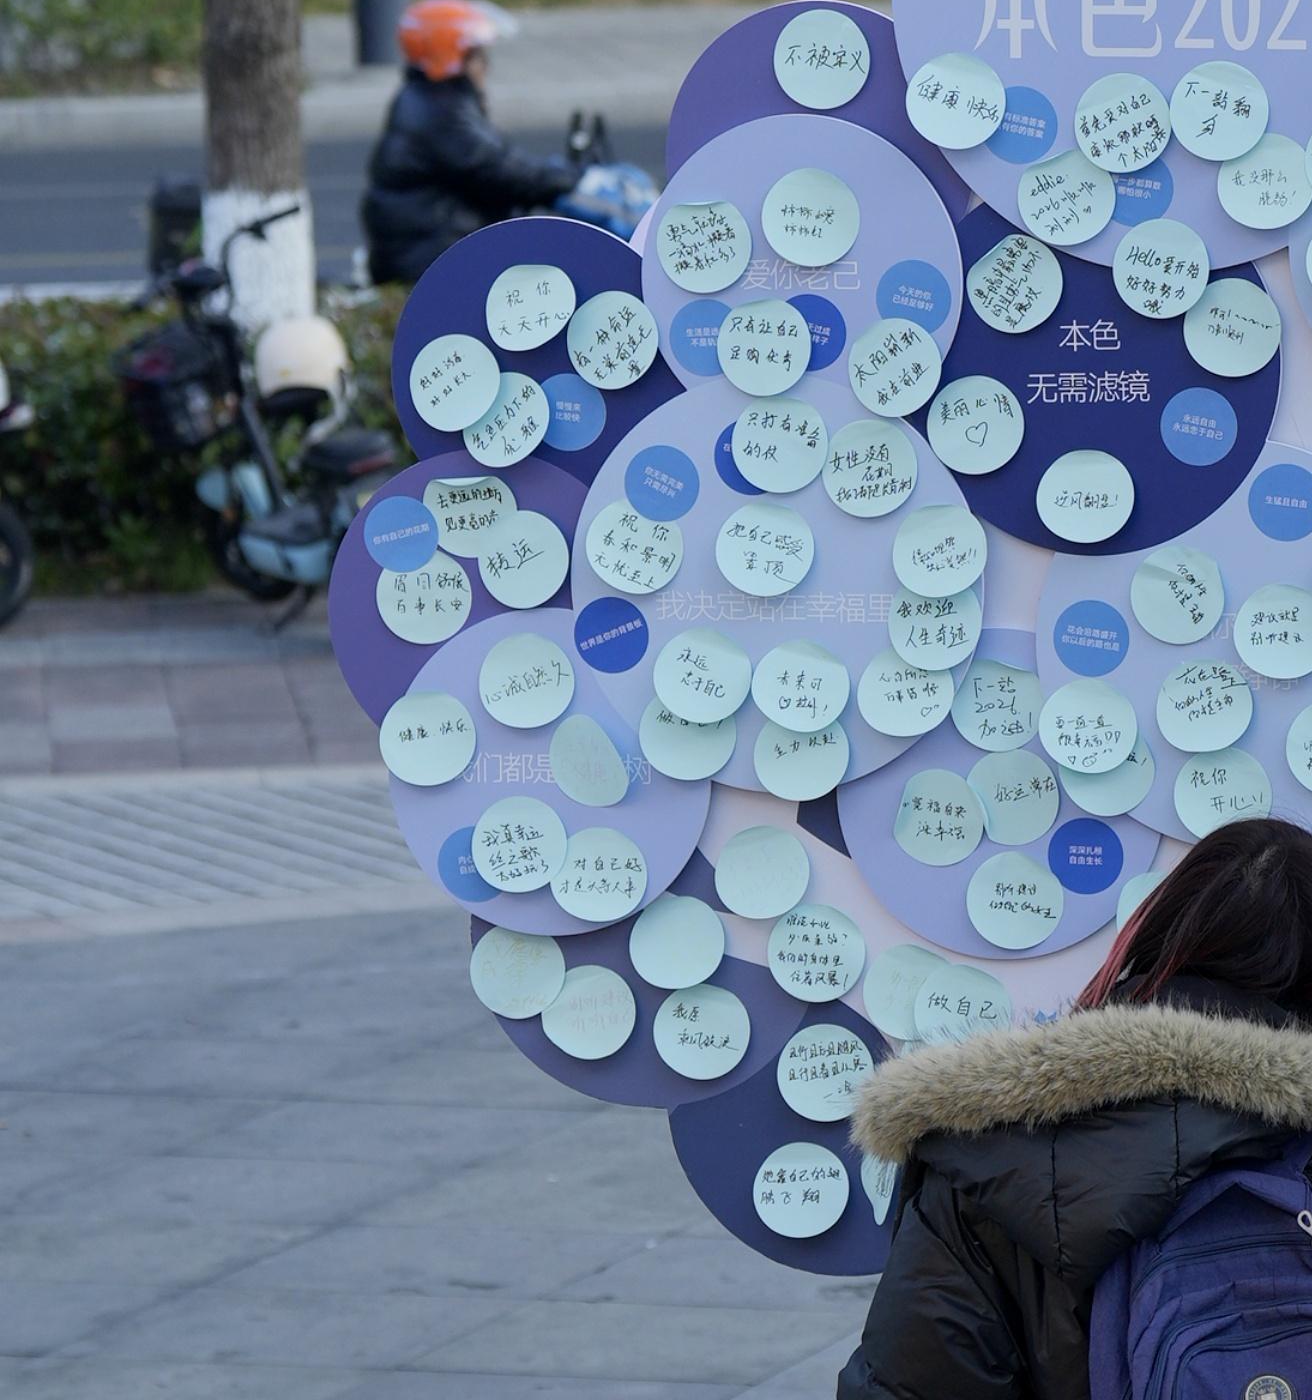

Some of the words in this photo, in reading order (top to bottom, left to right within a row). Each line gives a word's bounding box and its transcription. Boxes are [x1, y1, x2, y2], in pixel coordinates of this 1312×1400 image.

[784, 42, 866, 74] 不被定义
[917, 75, 999, 125] 健康快乐
[1231, 168, 1288, 188] 我没那么
[505, 280, 551, 308] 祝你
[898, 284, 932, 300] 今天的你
[1126, 274, 1186, 300] 好好努力
[892, 294, 935, 312] 已经足够好
[497, 311, 570, 337] 天天开心
[729, 317, 800, 338] 只有让自己
[1059, 319, 1121, 352] 本色
[730, 346, 793, 373] 足够优秀
[855, 329, 922, 388] 太阳崭新
[1027, 370, 1150, 405] 无需滤镜
[939, 393, 1016, 424] 美丽心情
[1183, 414, 1217, 429] 永远自由
[746, 411, 822, 450] 只打有准备
[743, 440, 780, 463] 的仗
[829, 443, 889, 475] 女性没有
[861, 463, 893, 483] 花期
[437, 487, 503, 511] 去更远的地方
[373, 524, 430, 546] 你有自己的花期
[618, 511, 671, 542] 祝你
[487, 538, 545, 579] 转运
[602, 529, 676, 573] 春和景明
[594, 553, 657, 590] 无忧至上
[656, 589, 895, 624] 我决定站在幸福里
[897, 599, 959, 619] 我欢迎
[1251, 607, 1299, 628] 建议就是
[580, 617, 643, 651] 世界是你的背景板
[905, 624, 970, 649] 人生奇迹
[676, 648, 709, 672] 永远
[973, 677, 1017, 699] 下一站
[993, 776, 1056, 802] 好运常在
[1190, 767, 1228, 789] 祝你
[574, 856, 642, 872] 对自己好
[1068, 855, 1103, 866] 自由生长
[672, 1002, 701, 1022] 我愿
[928, 992, 998, 1020] 做自己
